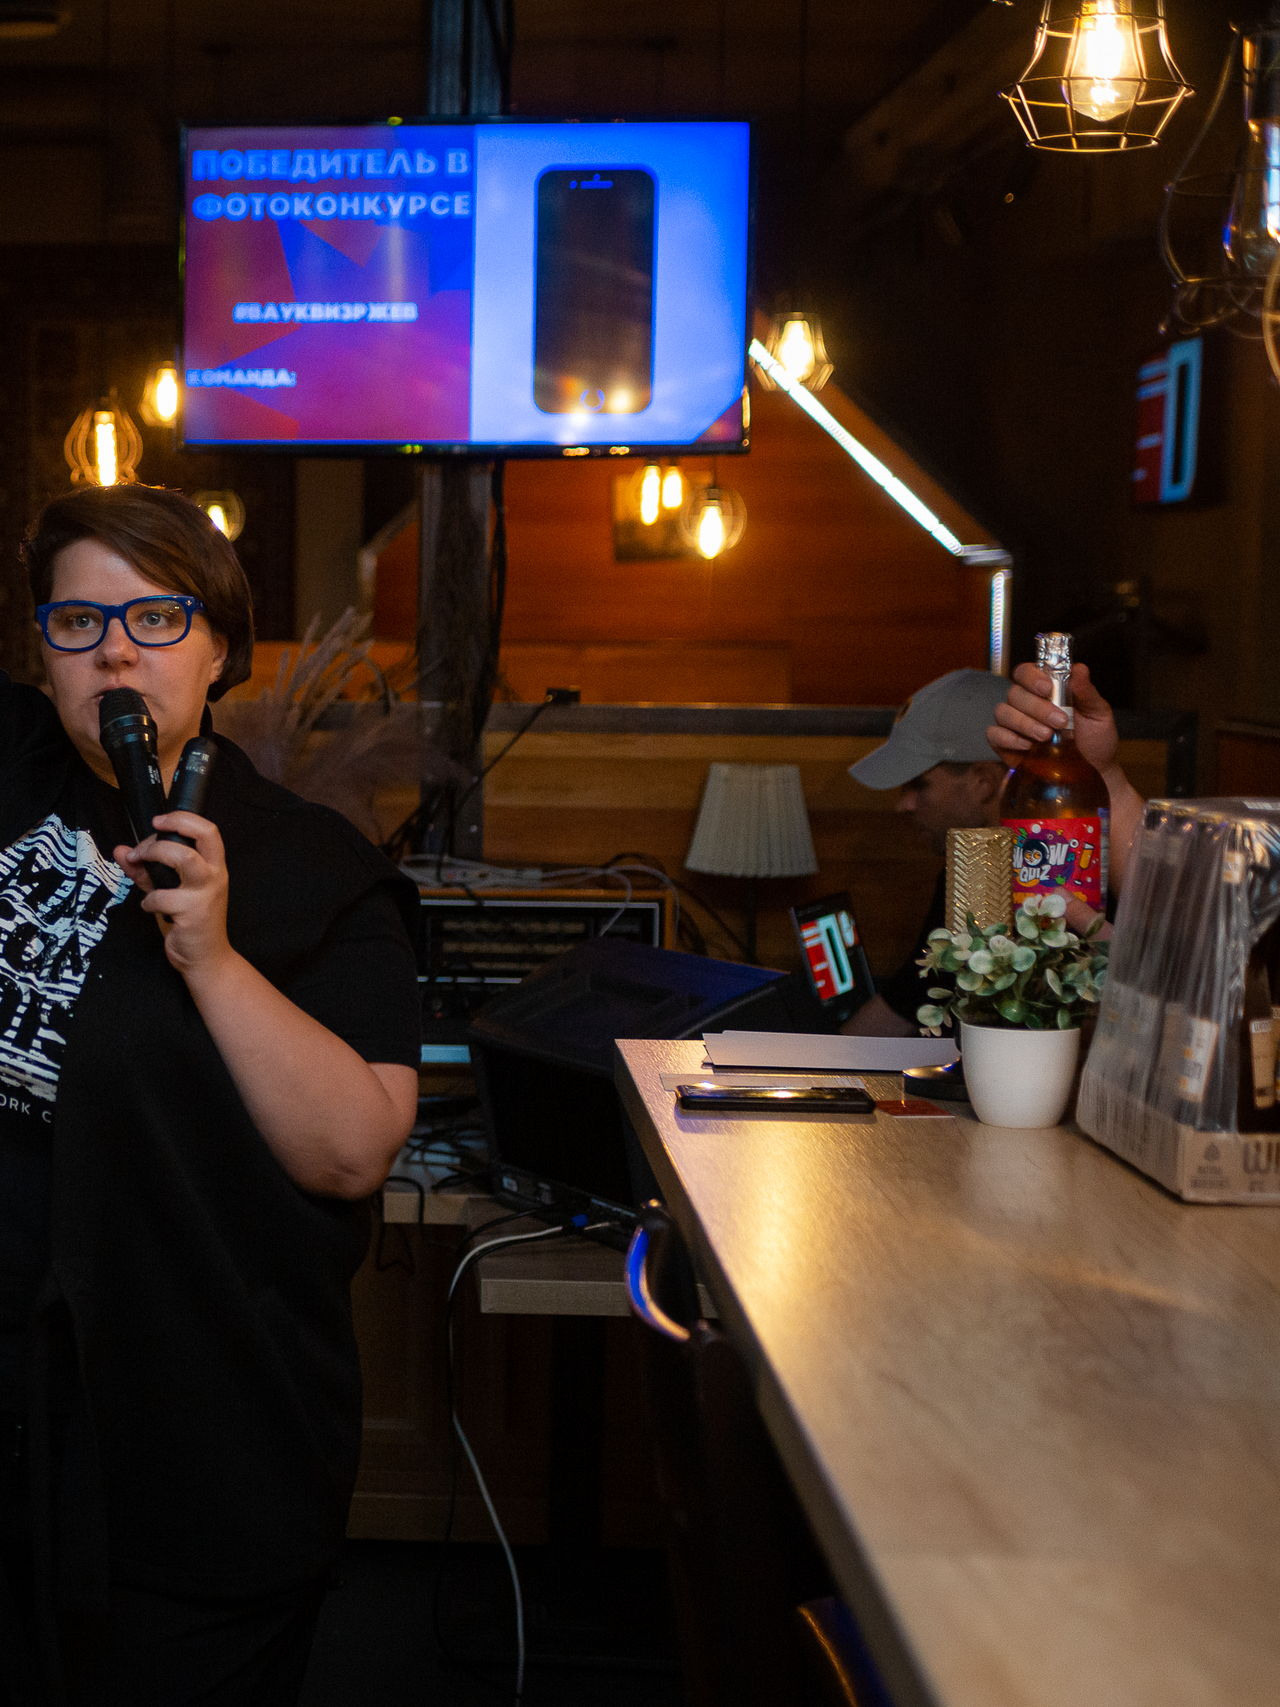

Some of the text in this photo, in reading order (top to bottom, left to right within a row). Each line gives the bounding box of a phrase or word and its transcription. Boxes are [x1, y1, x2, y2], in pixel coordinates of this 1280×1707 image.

[193, 149, 470, 183] ПОБЕДИТЕЛЬ В
[193, 193, 471, 220] ФОТОКОНКУРСЕ
[1020, 865, 1051, 882] QUIZ
